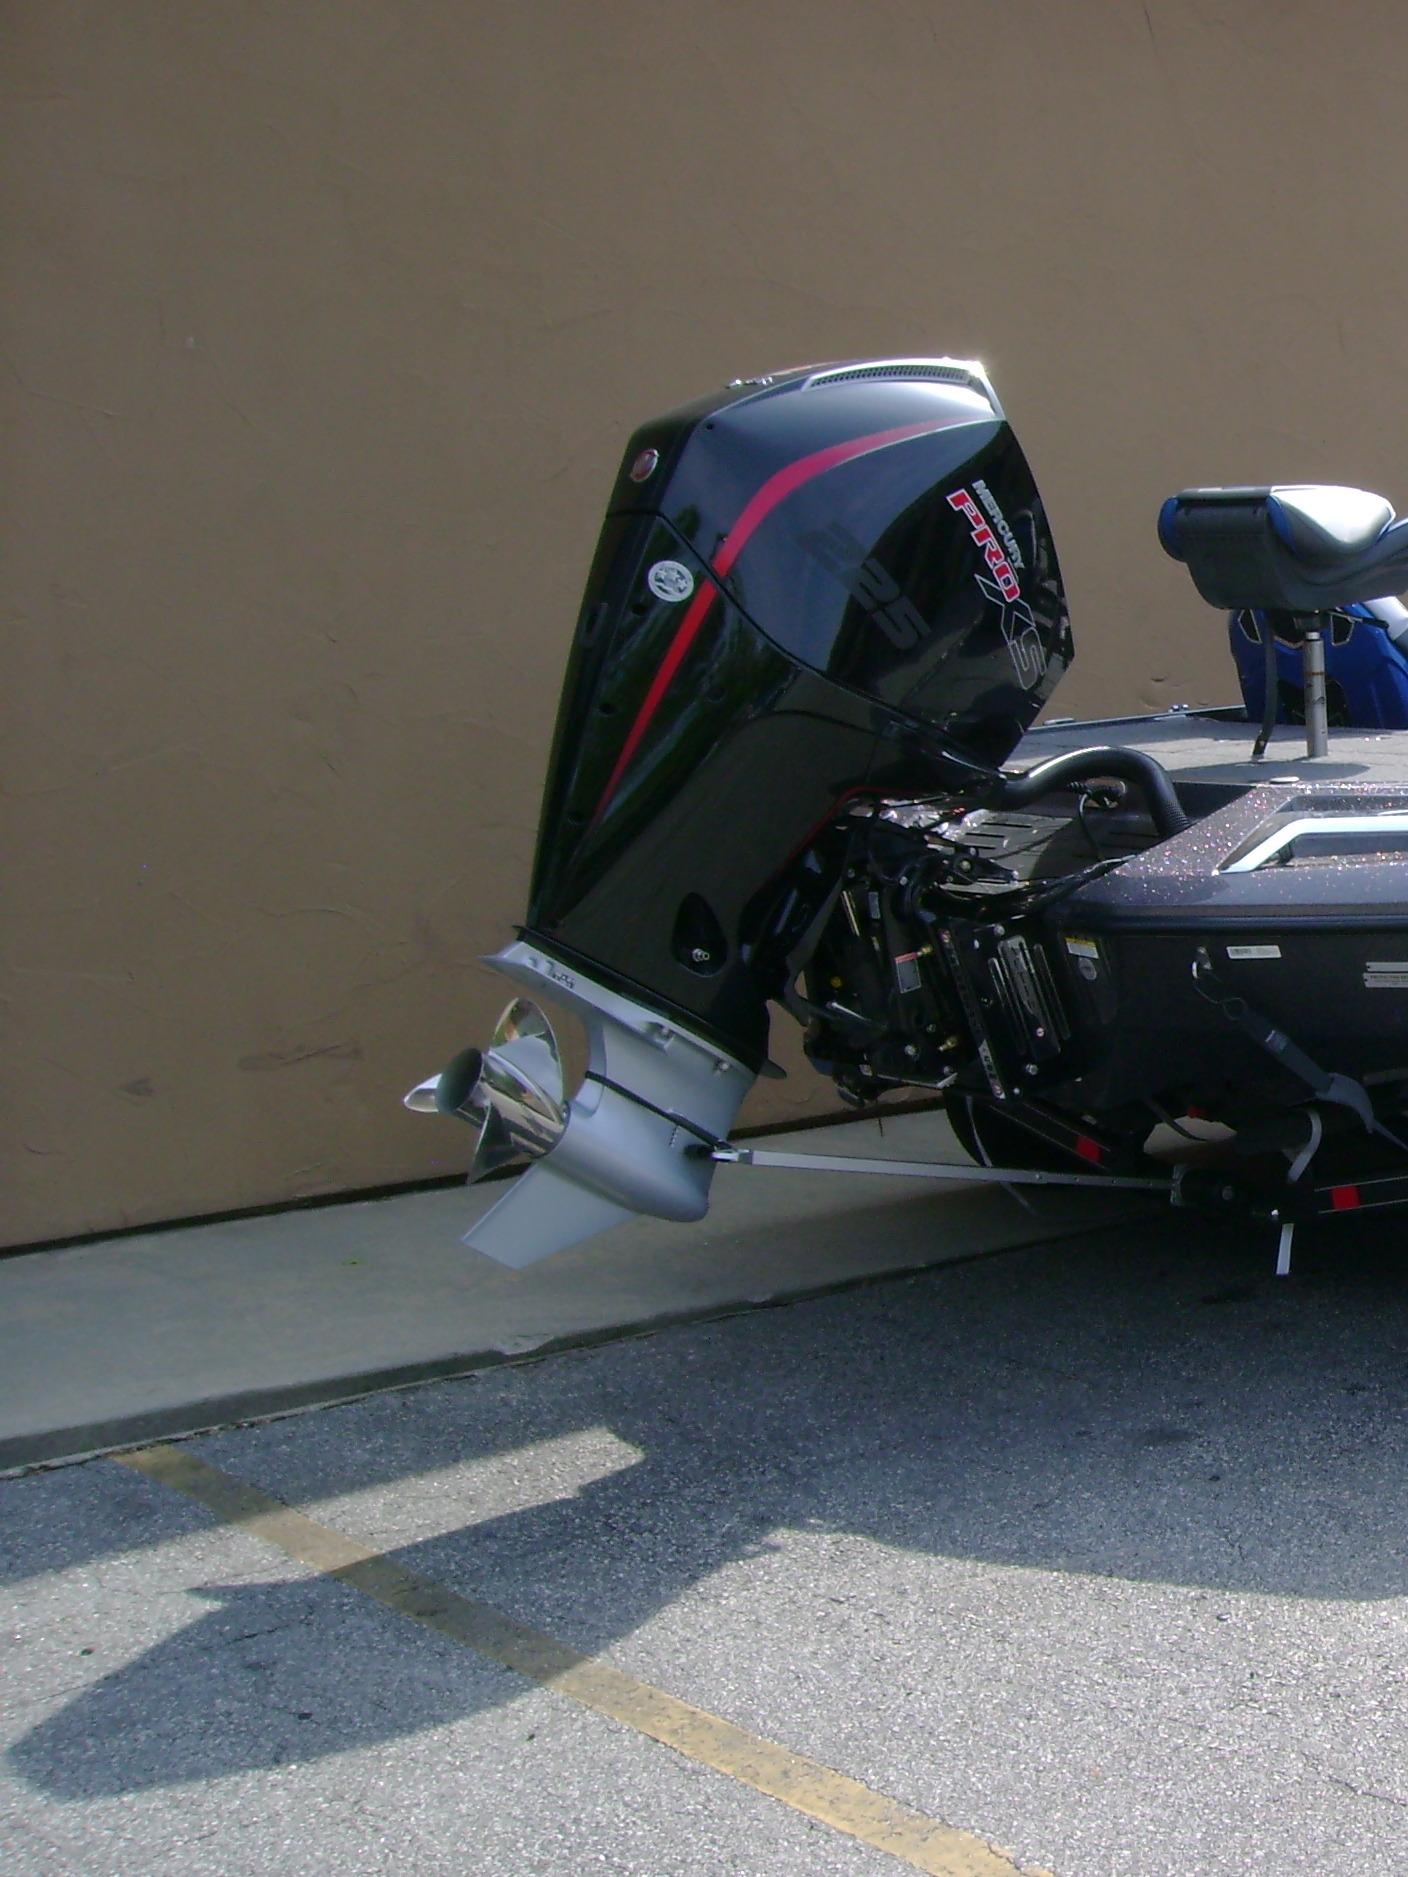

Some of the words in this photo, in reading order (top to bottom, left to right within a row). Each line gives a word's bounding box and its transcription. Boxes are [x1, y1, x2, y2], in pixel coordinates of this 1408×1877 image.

[946, 488, 1021, 603] PRO
[971, 479, 1025, 569] MERCURY
[974, 573, 1047, 690] XS
